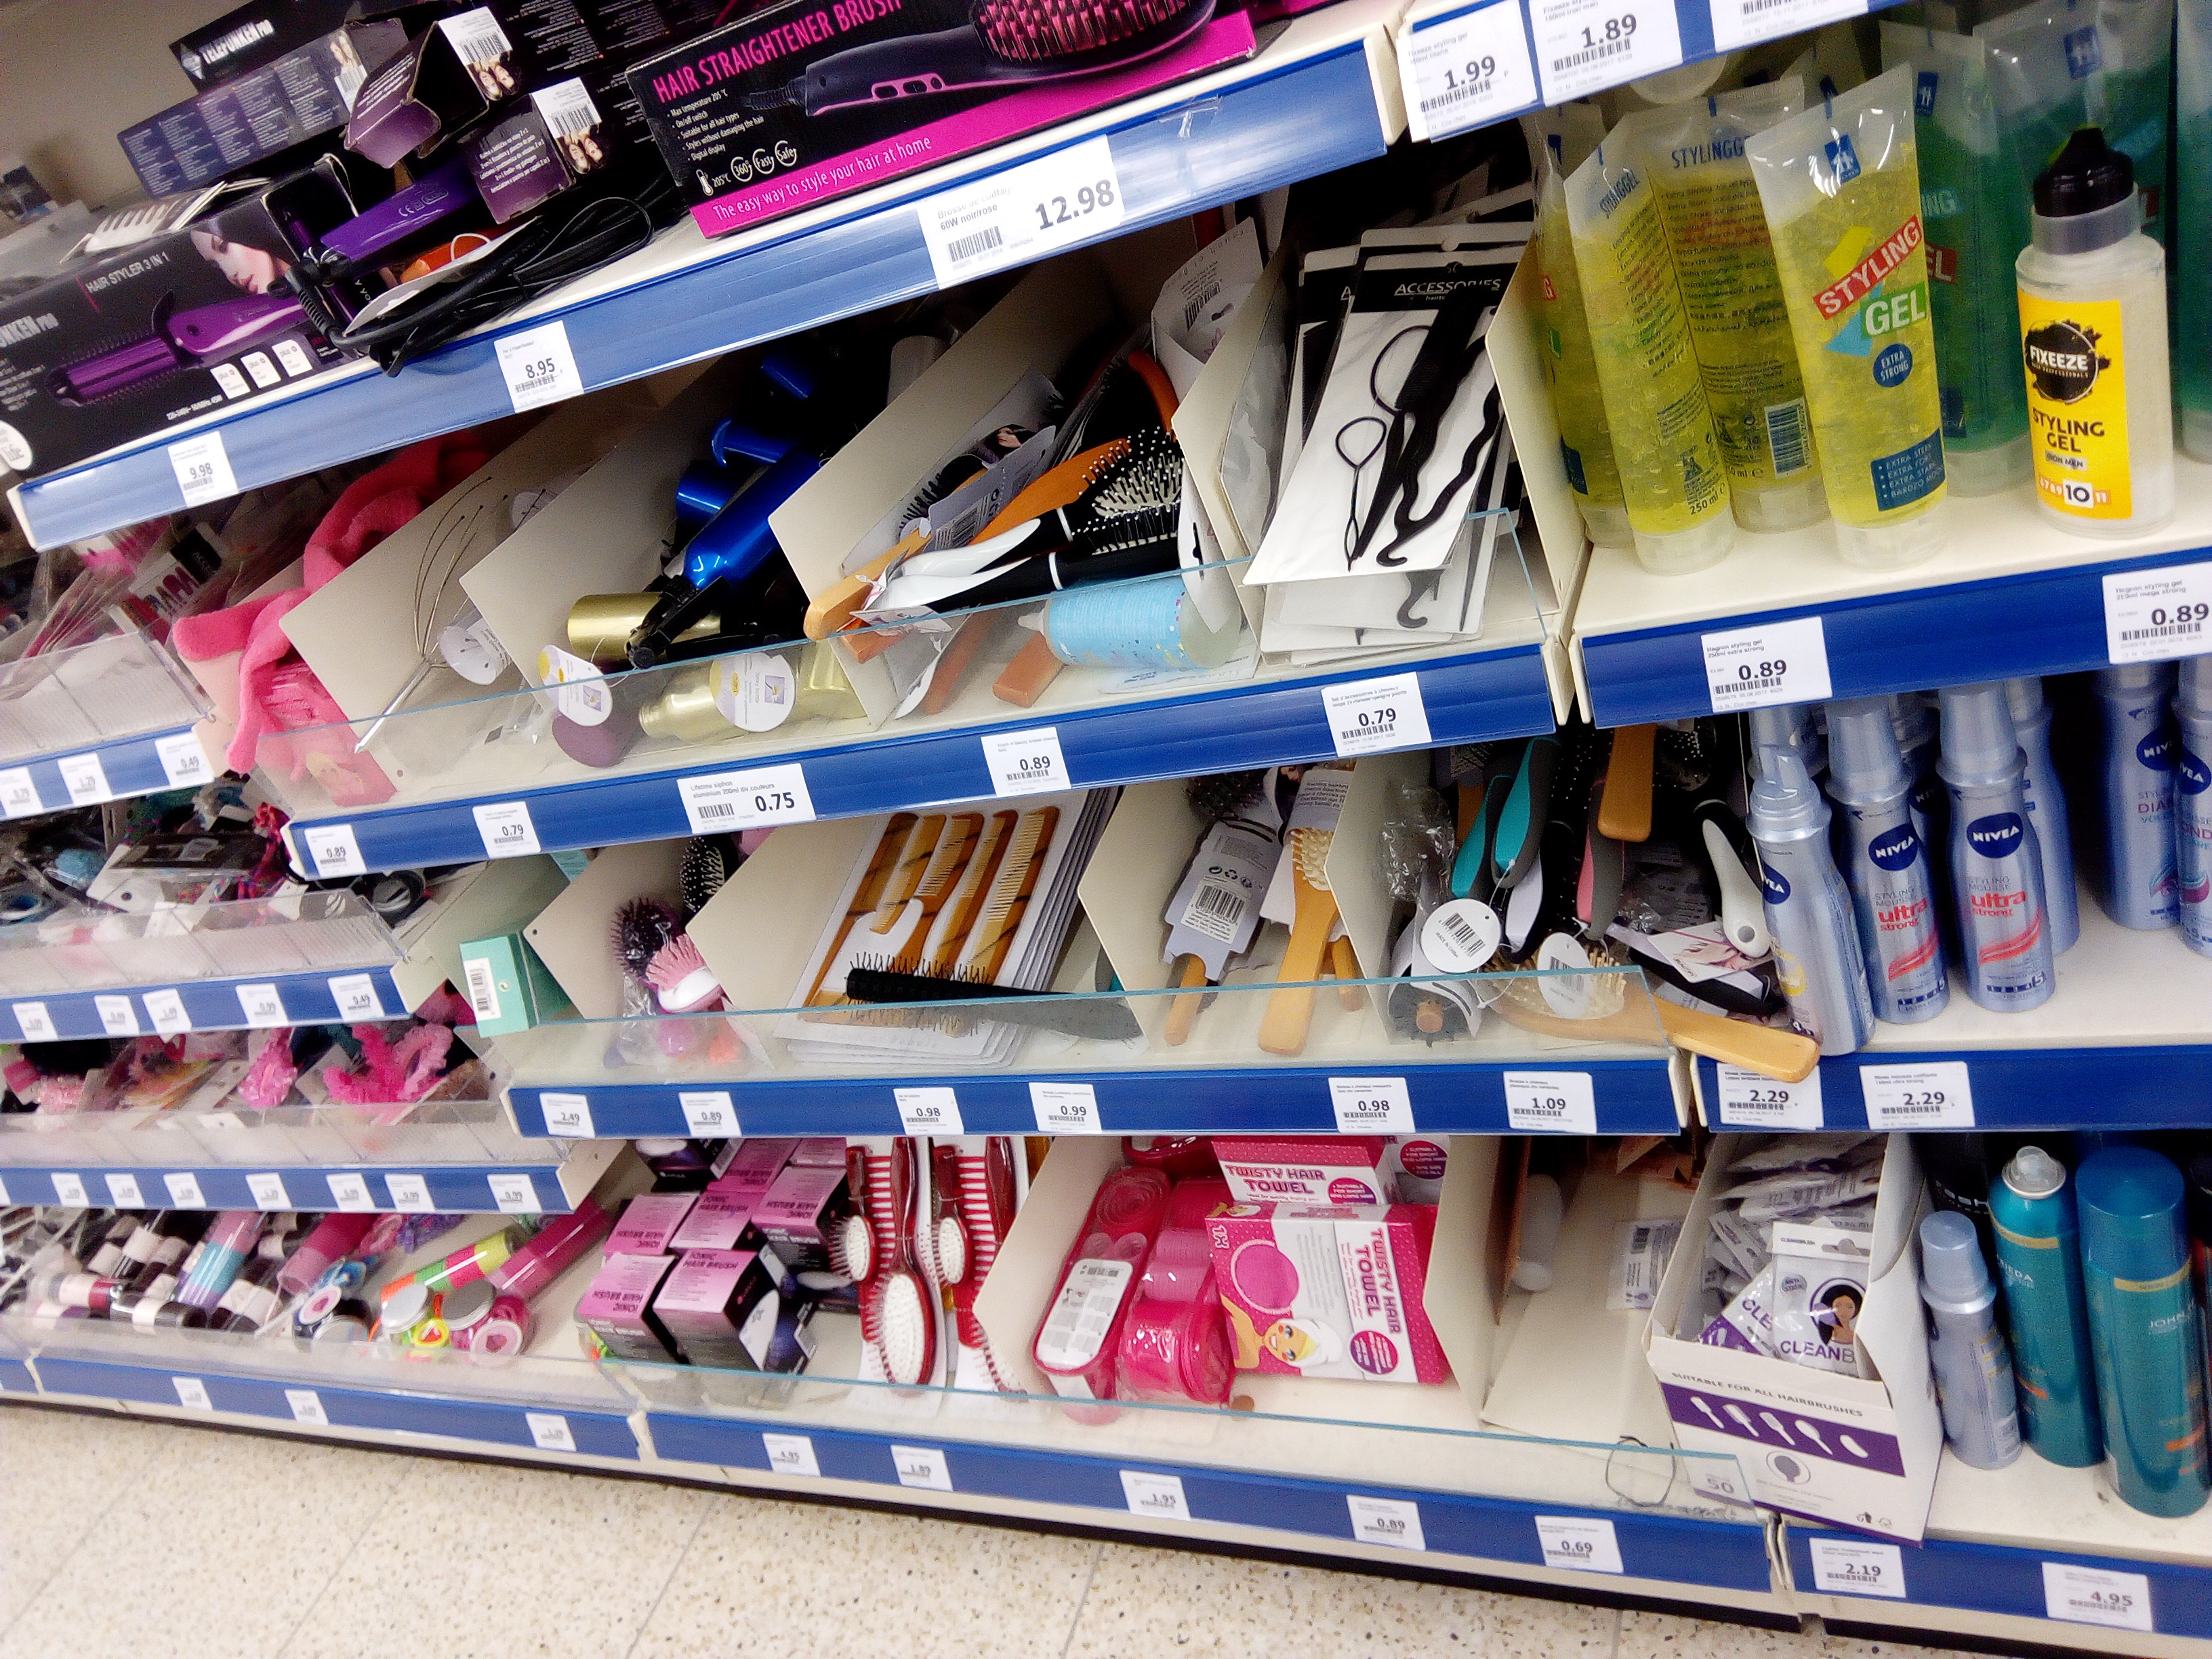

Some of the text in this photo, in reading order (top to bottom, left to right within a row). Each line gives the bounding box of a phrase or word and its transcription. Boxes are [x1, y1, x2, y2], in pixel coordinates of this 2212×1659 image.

[1581, 13, 1637, 48] 1.89
[199, 22, 260, 64] TELEFUNKEN
[653, 0, 902, 104] HAIR STRAIGHTENER BRUSH
[1444, 55, 1495, 90] 1.99
[715, 117, 726, 127] hair
[744, 119, 754, 129] the
[752, 115, 765, 127] hair
[755, 155, 771, 169] Fast
[776, 147, 794, 162] Safe
[1671, 137, 1746, 169] STYLINGG
[713, 136, 932, 222] The easy way to style your hair at home
[1035, 179, 1115, 230] 12.98
[939, 203, 998, 231] 60W noir/rose
[85, 276, 110, 293] HAIR
[108, 261, 143, 285] STYLER
[143, 259, 152, 270] 3
[150, 254, 164, 268] IN
[1819, 221, 1921, 314] STYLING
[1394, 279, 1502, 297] ACCESSOS
[1865, 289, 1926, 336] GEL
[525, 357, 555, 379] 8.95
[1881, 350, 1905, 369] EXTRA
[2030, 344, 2089, 372] FIXEEZE
[1880, 360, 1910, 382] STRONG
[2032, 407, 2106, 437] STYLING
[2047, 432, 2083, 453] GEL
[190, 462, 213, 480] 9.98
[2065, 483, 2090, 503] 10
[1689, 491, 1719, 516] 250 ml
[2171, 579, 2183, 587] gel
[2150, 602, 2210, 626] 0.89
[1730, 640, 1752, 649] styling
[1753, 638, 1763, 647] gel
[1738, 659, 1787, 680] 0.89
[1358, 708, 1397, 726] 0.79
[1019, 756, 1050, 771] 0.89
[755, 792, 796, 812] 0.75
[501, 824, 525, 838] 0.79
[1971, 824, 2020, 844] NIVEA
[326, 846, 347, 859] 0.89
[1875, 836, 1916, 859] NIVEA
[1971, 890, 2026, 908] ultra
[1878, 897, 1929, 923] ultra
[1357, 1100, 1391, 1111] 0.98
[1531, 1097, 1566, 1109] 1.09
[1749, 1089, 1790, 1103] 2.29
[1902, 1091, 1946, 1106] 2.29
[700, 1111, 722, 1122] 0.89
[916, 1107, 941, 1118] 0.98
[1061, 1105, 1087, 1117] 0.99
[1225, 1164, 1327, 1181] TWISTY HAIR
[1243, 1179, 1315, 1194] TOWEL
[1355, 1244, 1381, 1317] TOWEL
[1371, 1227, 1403, 1335] TWISTY HAIR
[1780, 1340, 1856, 1364] CLEANB
[1671, 1371, 1864, 1417] SUITABLE FOR ALL HAIRBRUSHES
[1561, 1540, 1593, 1553] 0.69
[1845, 1563, 1882, 1577] 2.19
[2090, 1591, 2134, 1607] 4.95
